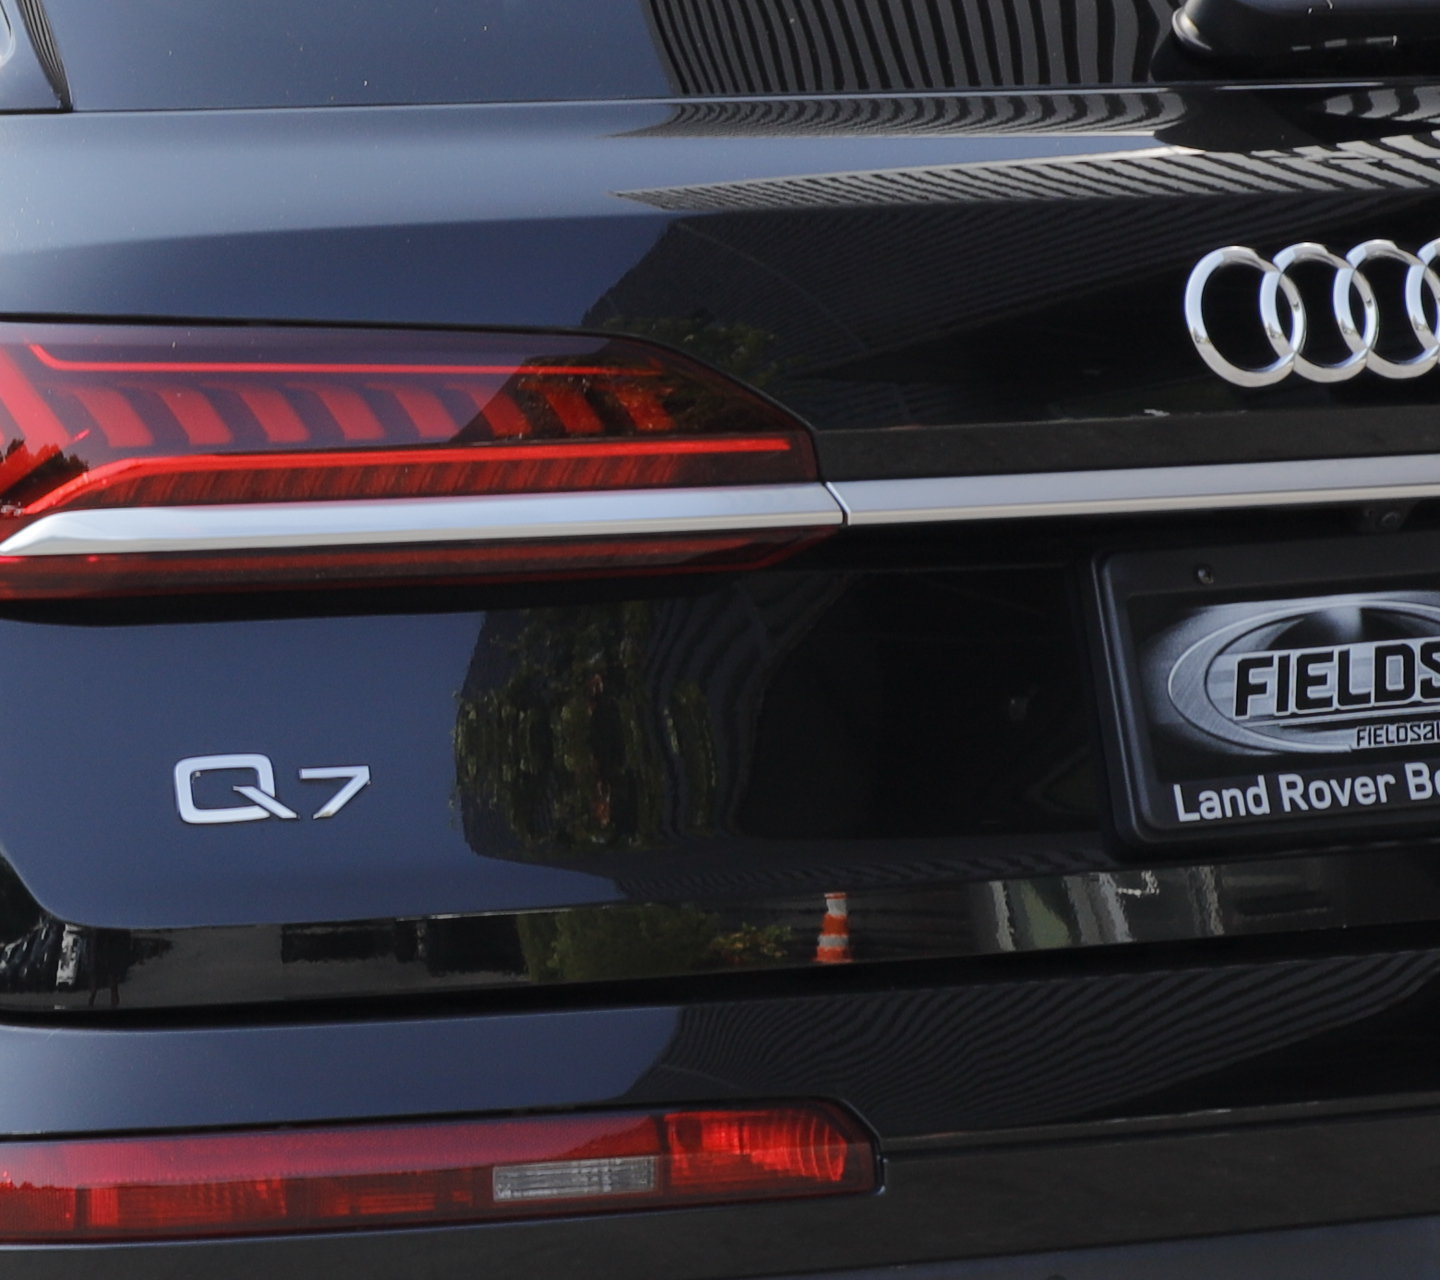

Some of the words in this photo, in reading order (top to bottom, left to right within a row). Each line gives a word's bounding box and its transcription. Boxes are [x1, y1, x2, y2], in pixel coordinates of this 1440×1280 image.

[174, 753, 371, 824] Q7
[1173, 774, 1271, 823] Land
[1279, 769, 1395, 812] Rover
